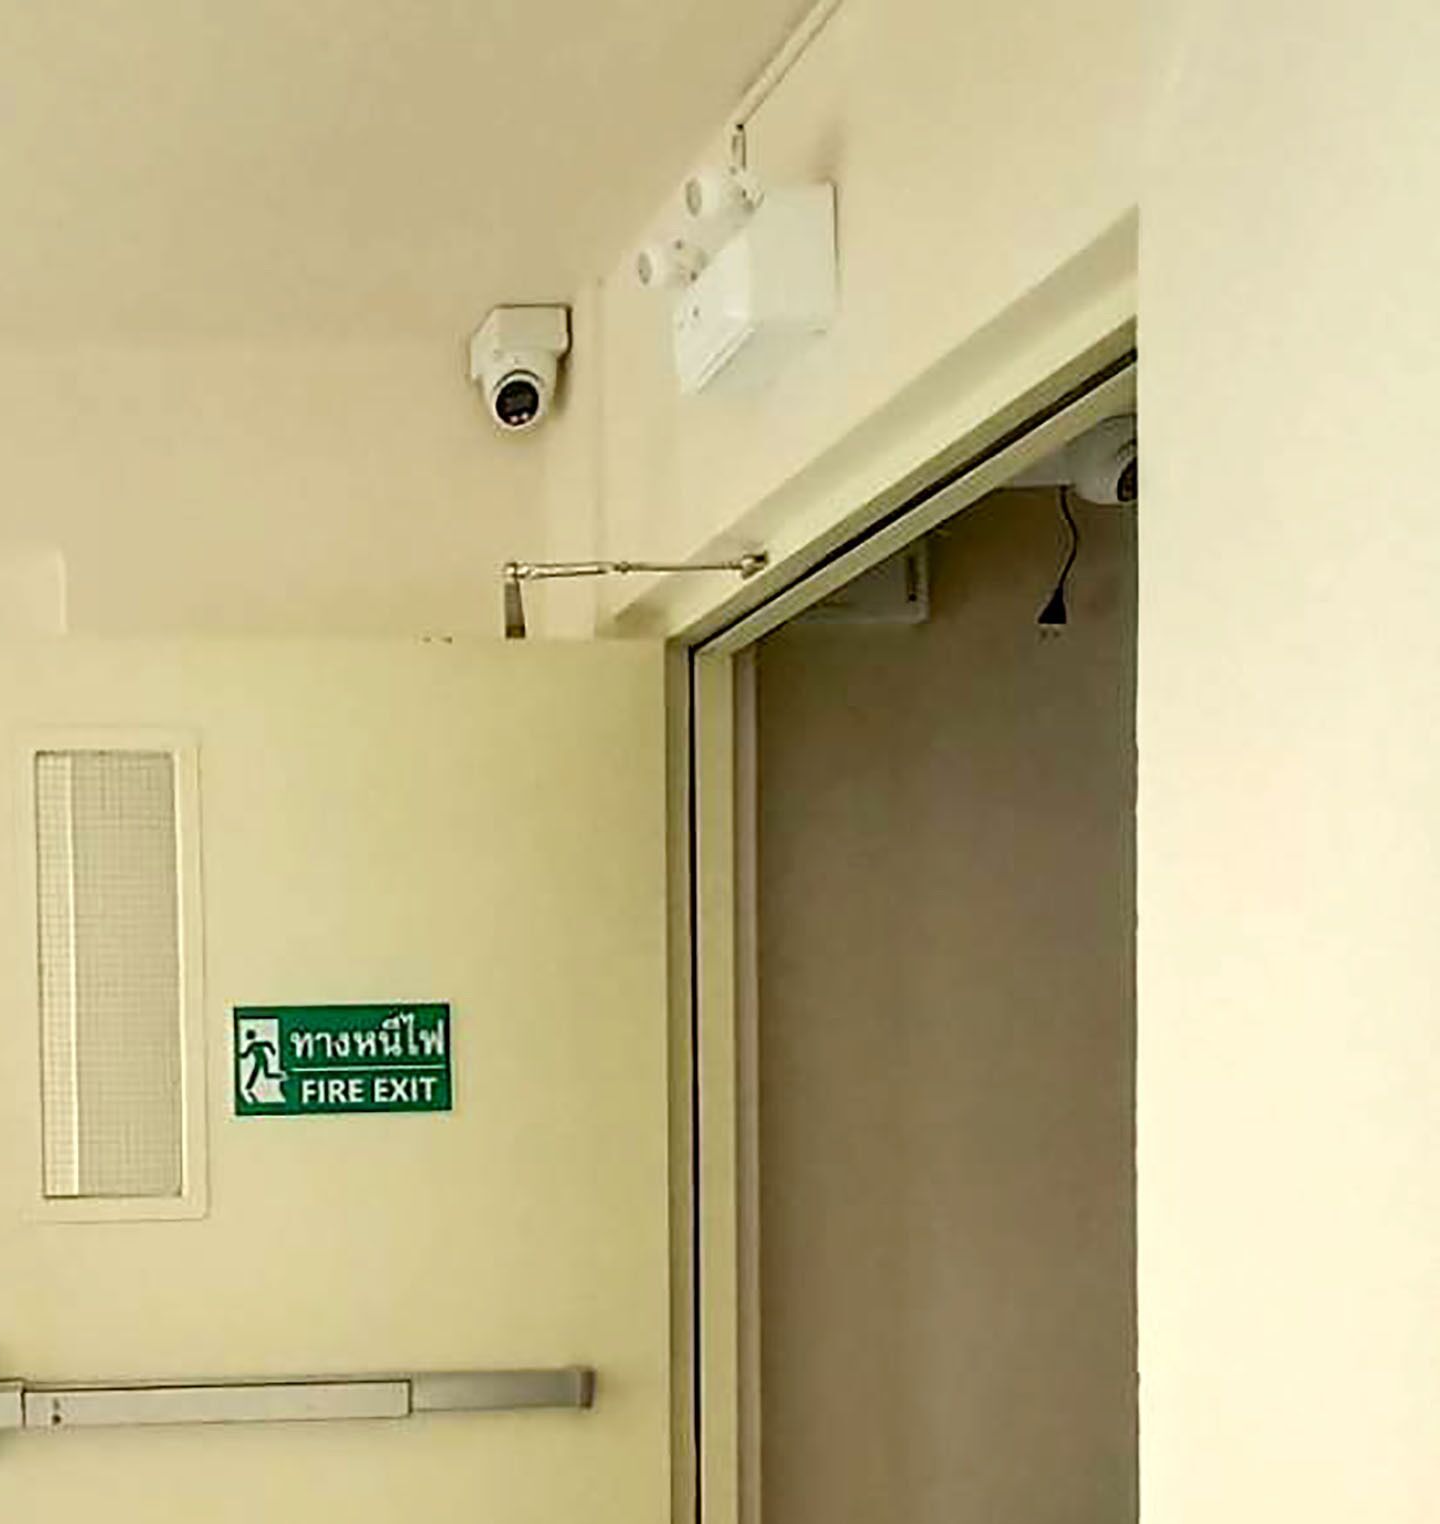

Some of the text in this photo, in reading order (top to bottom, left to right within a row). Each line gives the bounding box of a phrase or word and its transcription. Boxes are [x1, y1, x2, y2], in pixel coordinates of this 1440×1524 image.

[290, 1010, 445, 1058] ทางหนีไฟ
[301, 1076, 438, 1104] FIRE EXIT
